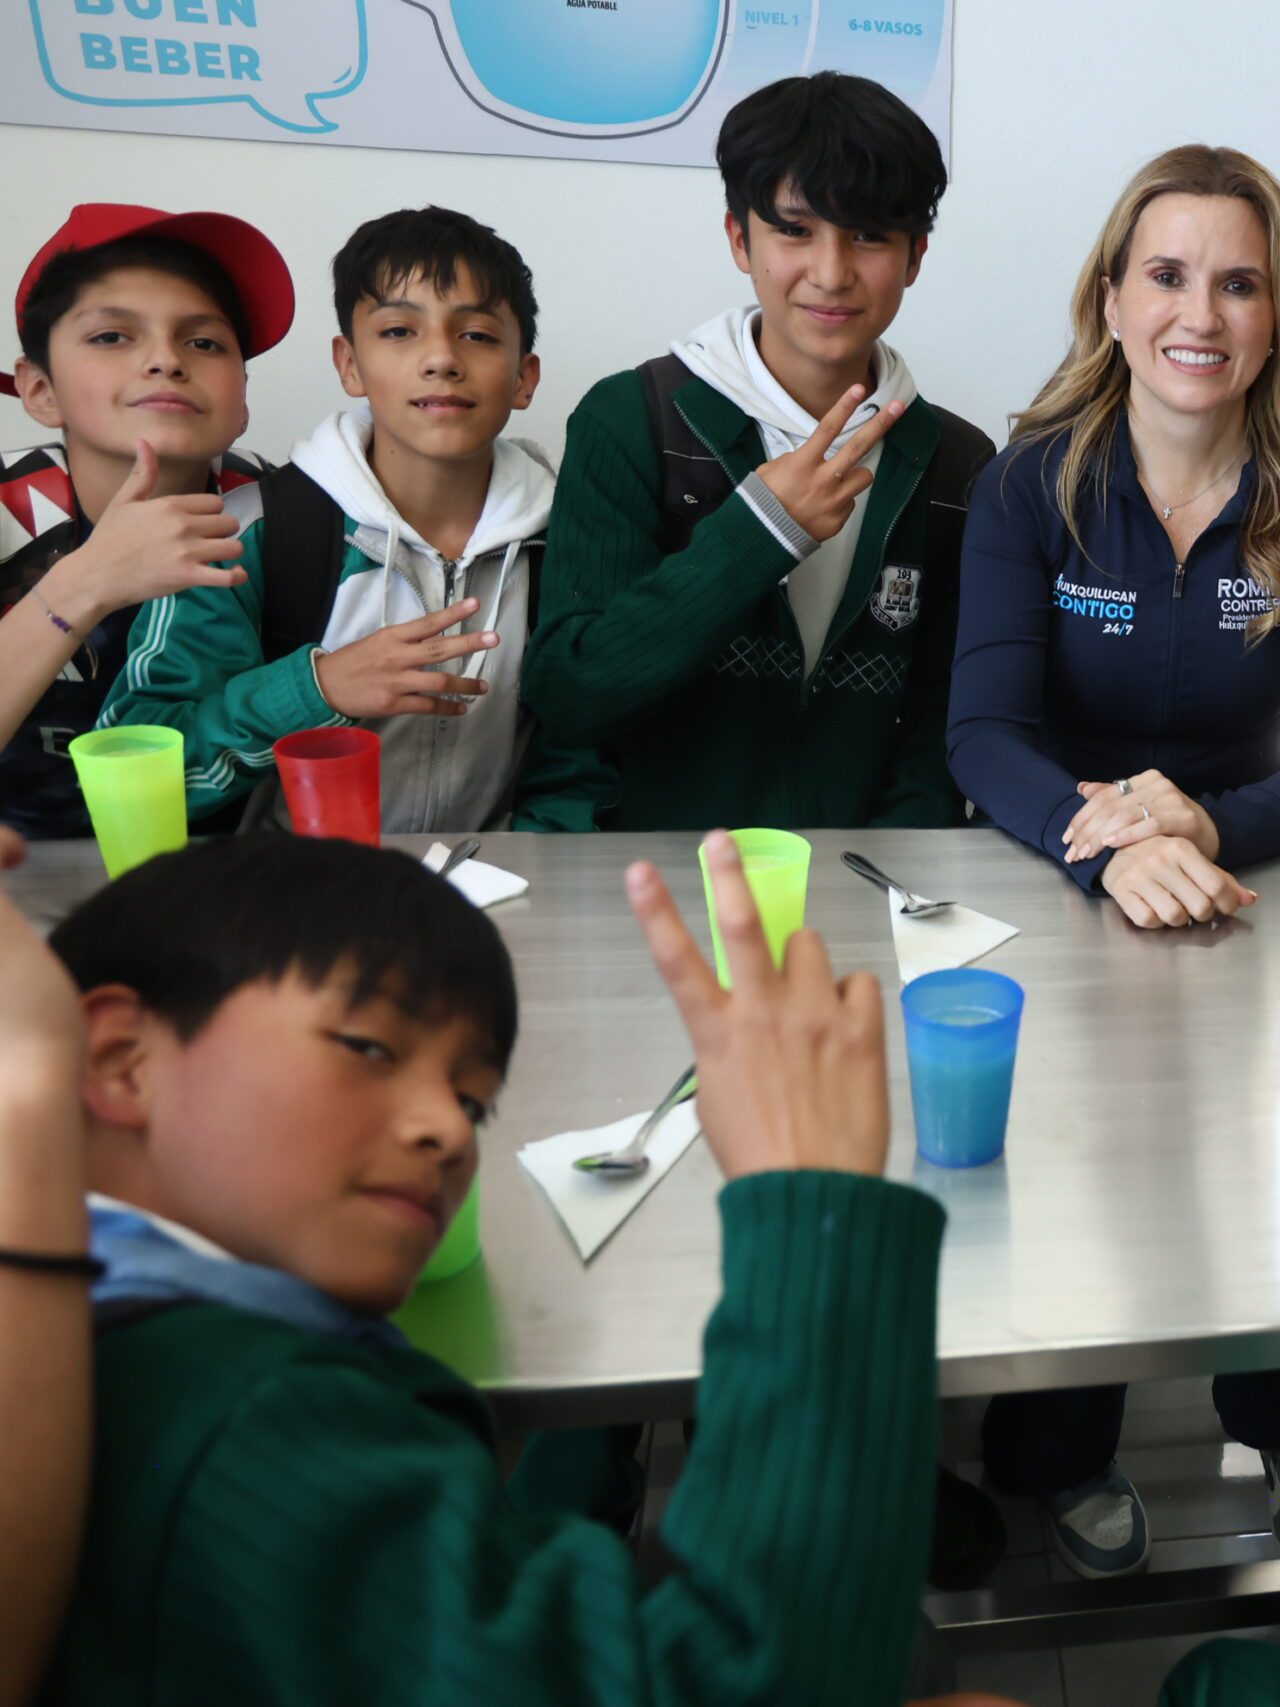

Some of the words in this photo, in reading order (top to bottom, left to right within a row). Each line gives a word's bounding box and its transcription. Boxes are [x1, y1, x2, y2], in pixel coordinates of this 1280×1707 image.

[567, 0, 586, 8] AGUA
[588, 1, 618, 10] POTABLE
[745, 10, 788, 25] NIVEL
[792, 15, 799, 26] 1
[849, 19, 872, 32] 6-8
[874, 20, 922, 36] VASOS
[80, 33, 262, 81] BEBER
[1102, 623, 1133, 635] 24/7
